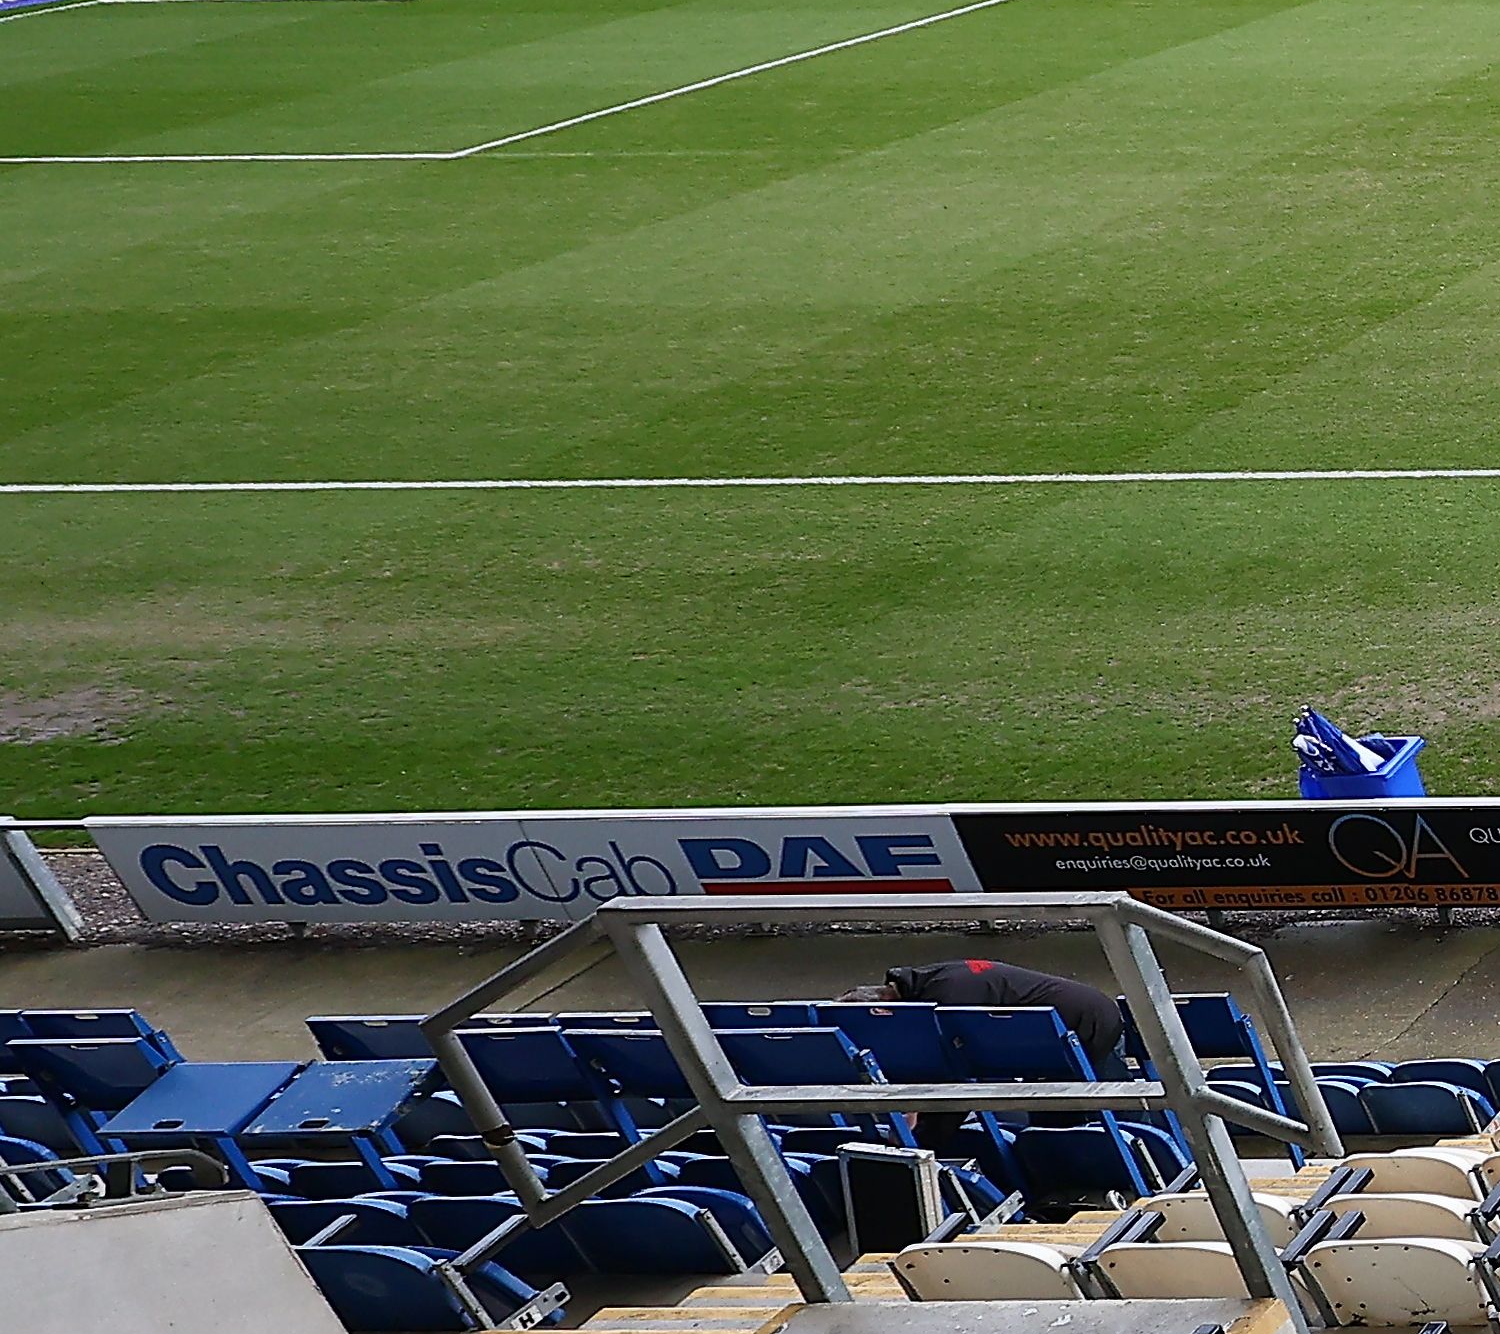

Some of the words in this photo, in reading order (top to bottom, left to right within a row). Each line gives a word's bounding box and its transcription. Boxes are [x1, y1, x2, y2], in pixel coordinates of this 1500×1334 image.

[1004, 822, 1305, 853] www.qualityac.co.uk
[1327, 812, 1470, 879] QA
[138, 840, 678, 906] ChassisCab
[676, 833, 943, 880] DAF
[1055, 853, 1272, 873] enquiries@qualityac.co.uk
[1142, 890, 1176, 907] For
[1183, 889, 1210, 907] all
[1213, 889, 1307, 908] enquiries
[1310, 887, 1346, 905] call
[1364, 886, 1429, 905] 01206
